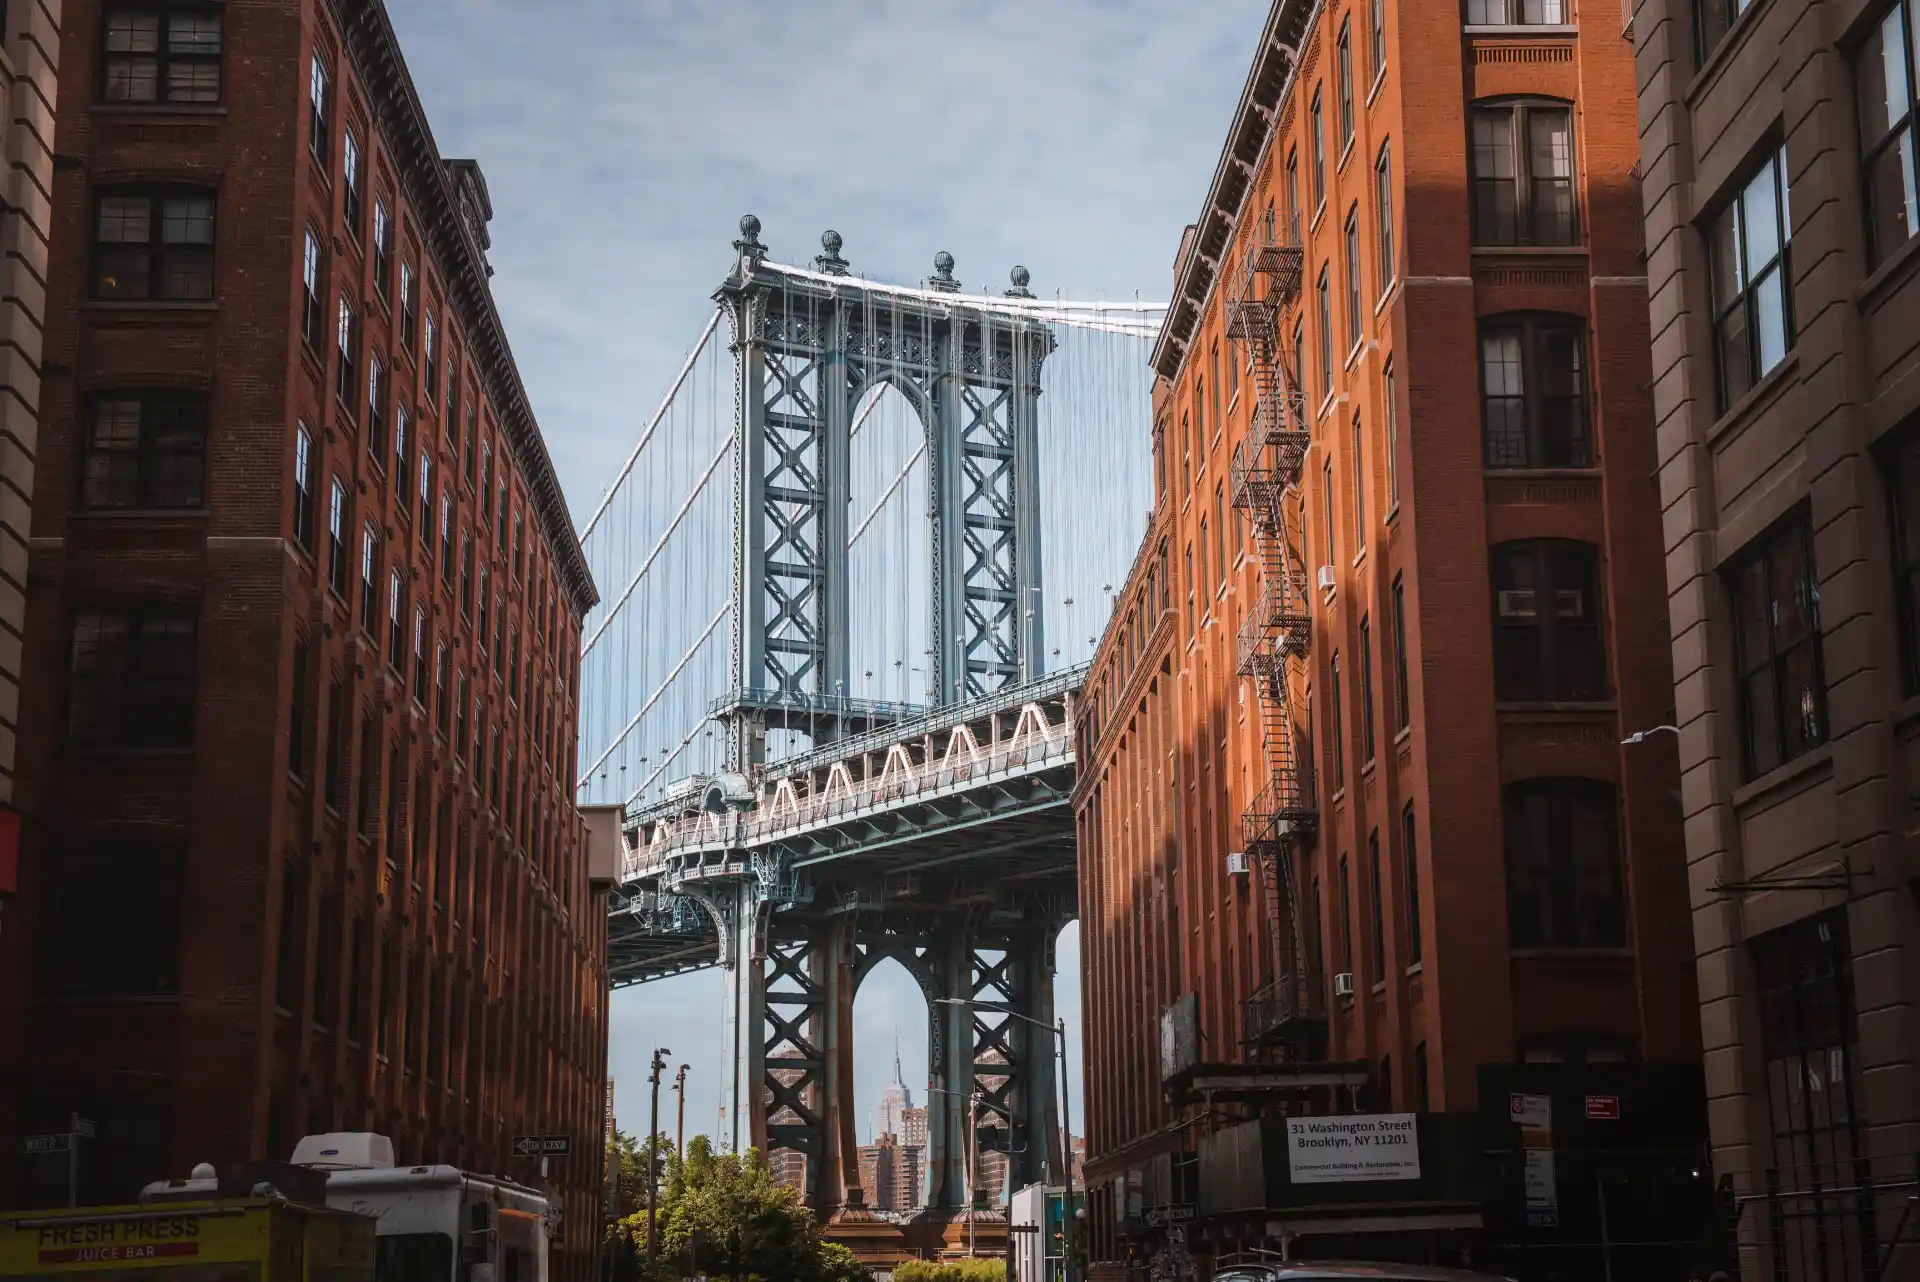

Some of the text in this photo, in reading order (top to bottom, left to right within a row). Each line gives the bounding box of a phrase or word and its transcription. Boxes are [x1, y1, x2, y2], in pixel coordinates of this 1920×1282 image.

[1291, 1120, 1413, 1134] 31 Washington Street
[521, 1142, 539, 1150] ONE
[1298, 1134, 1408, 1149] Brooklyn, NY 11201
[1294, 1163, 1331, 1171] Commercial
[1332, 1161, 1358, 1170] Building
[39, 1218, 200, 1246] FRESH PRESS
[75, 1245, 155, 1261] JUICE BAR
